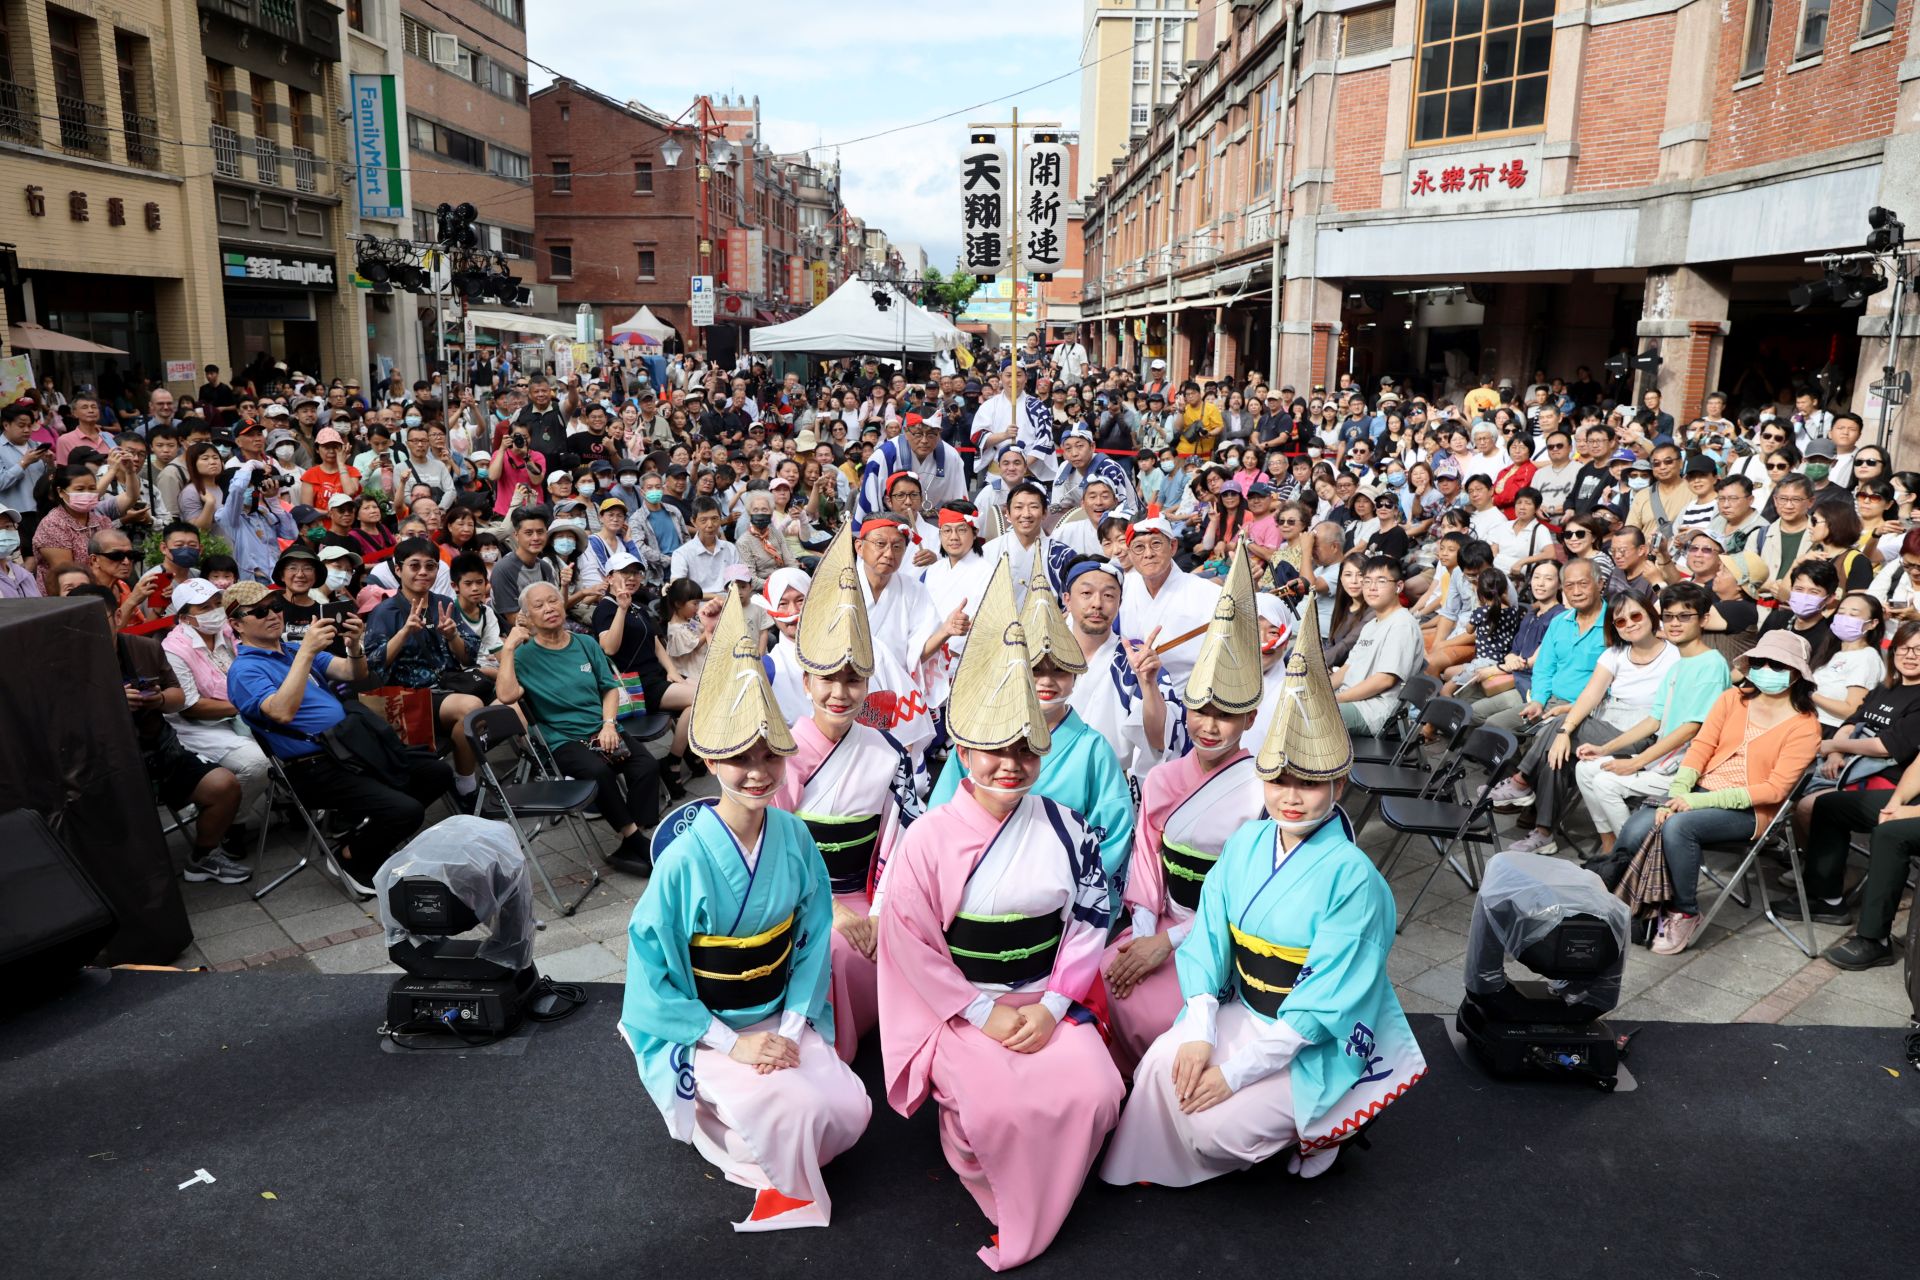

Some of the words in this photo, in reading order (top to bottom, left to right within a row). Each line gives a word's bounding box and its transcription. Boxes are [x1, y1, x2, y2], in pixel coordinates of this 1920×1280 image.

[360, 87, 381, 195] FamilyMart
[963, 153, 1001, 268] 天翔連
[1027, 151, 1061, 264] 開新連
[1410, 159, 1528, 197] 永樂市場
[272, 258, 333, 285] FamilyMart
[1863, 711, 1891, 725] LITTLE
